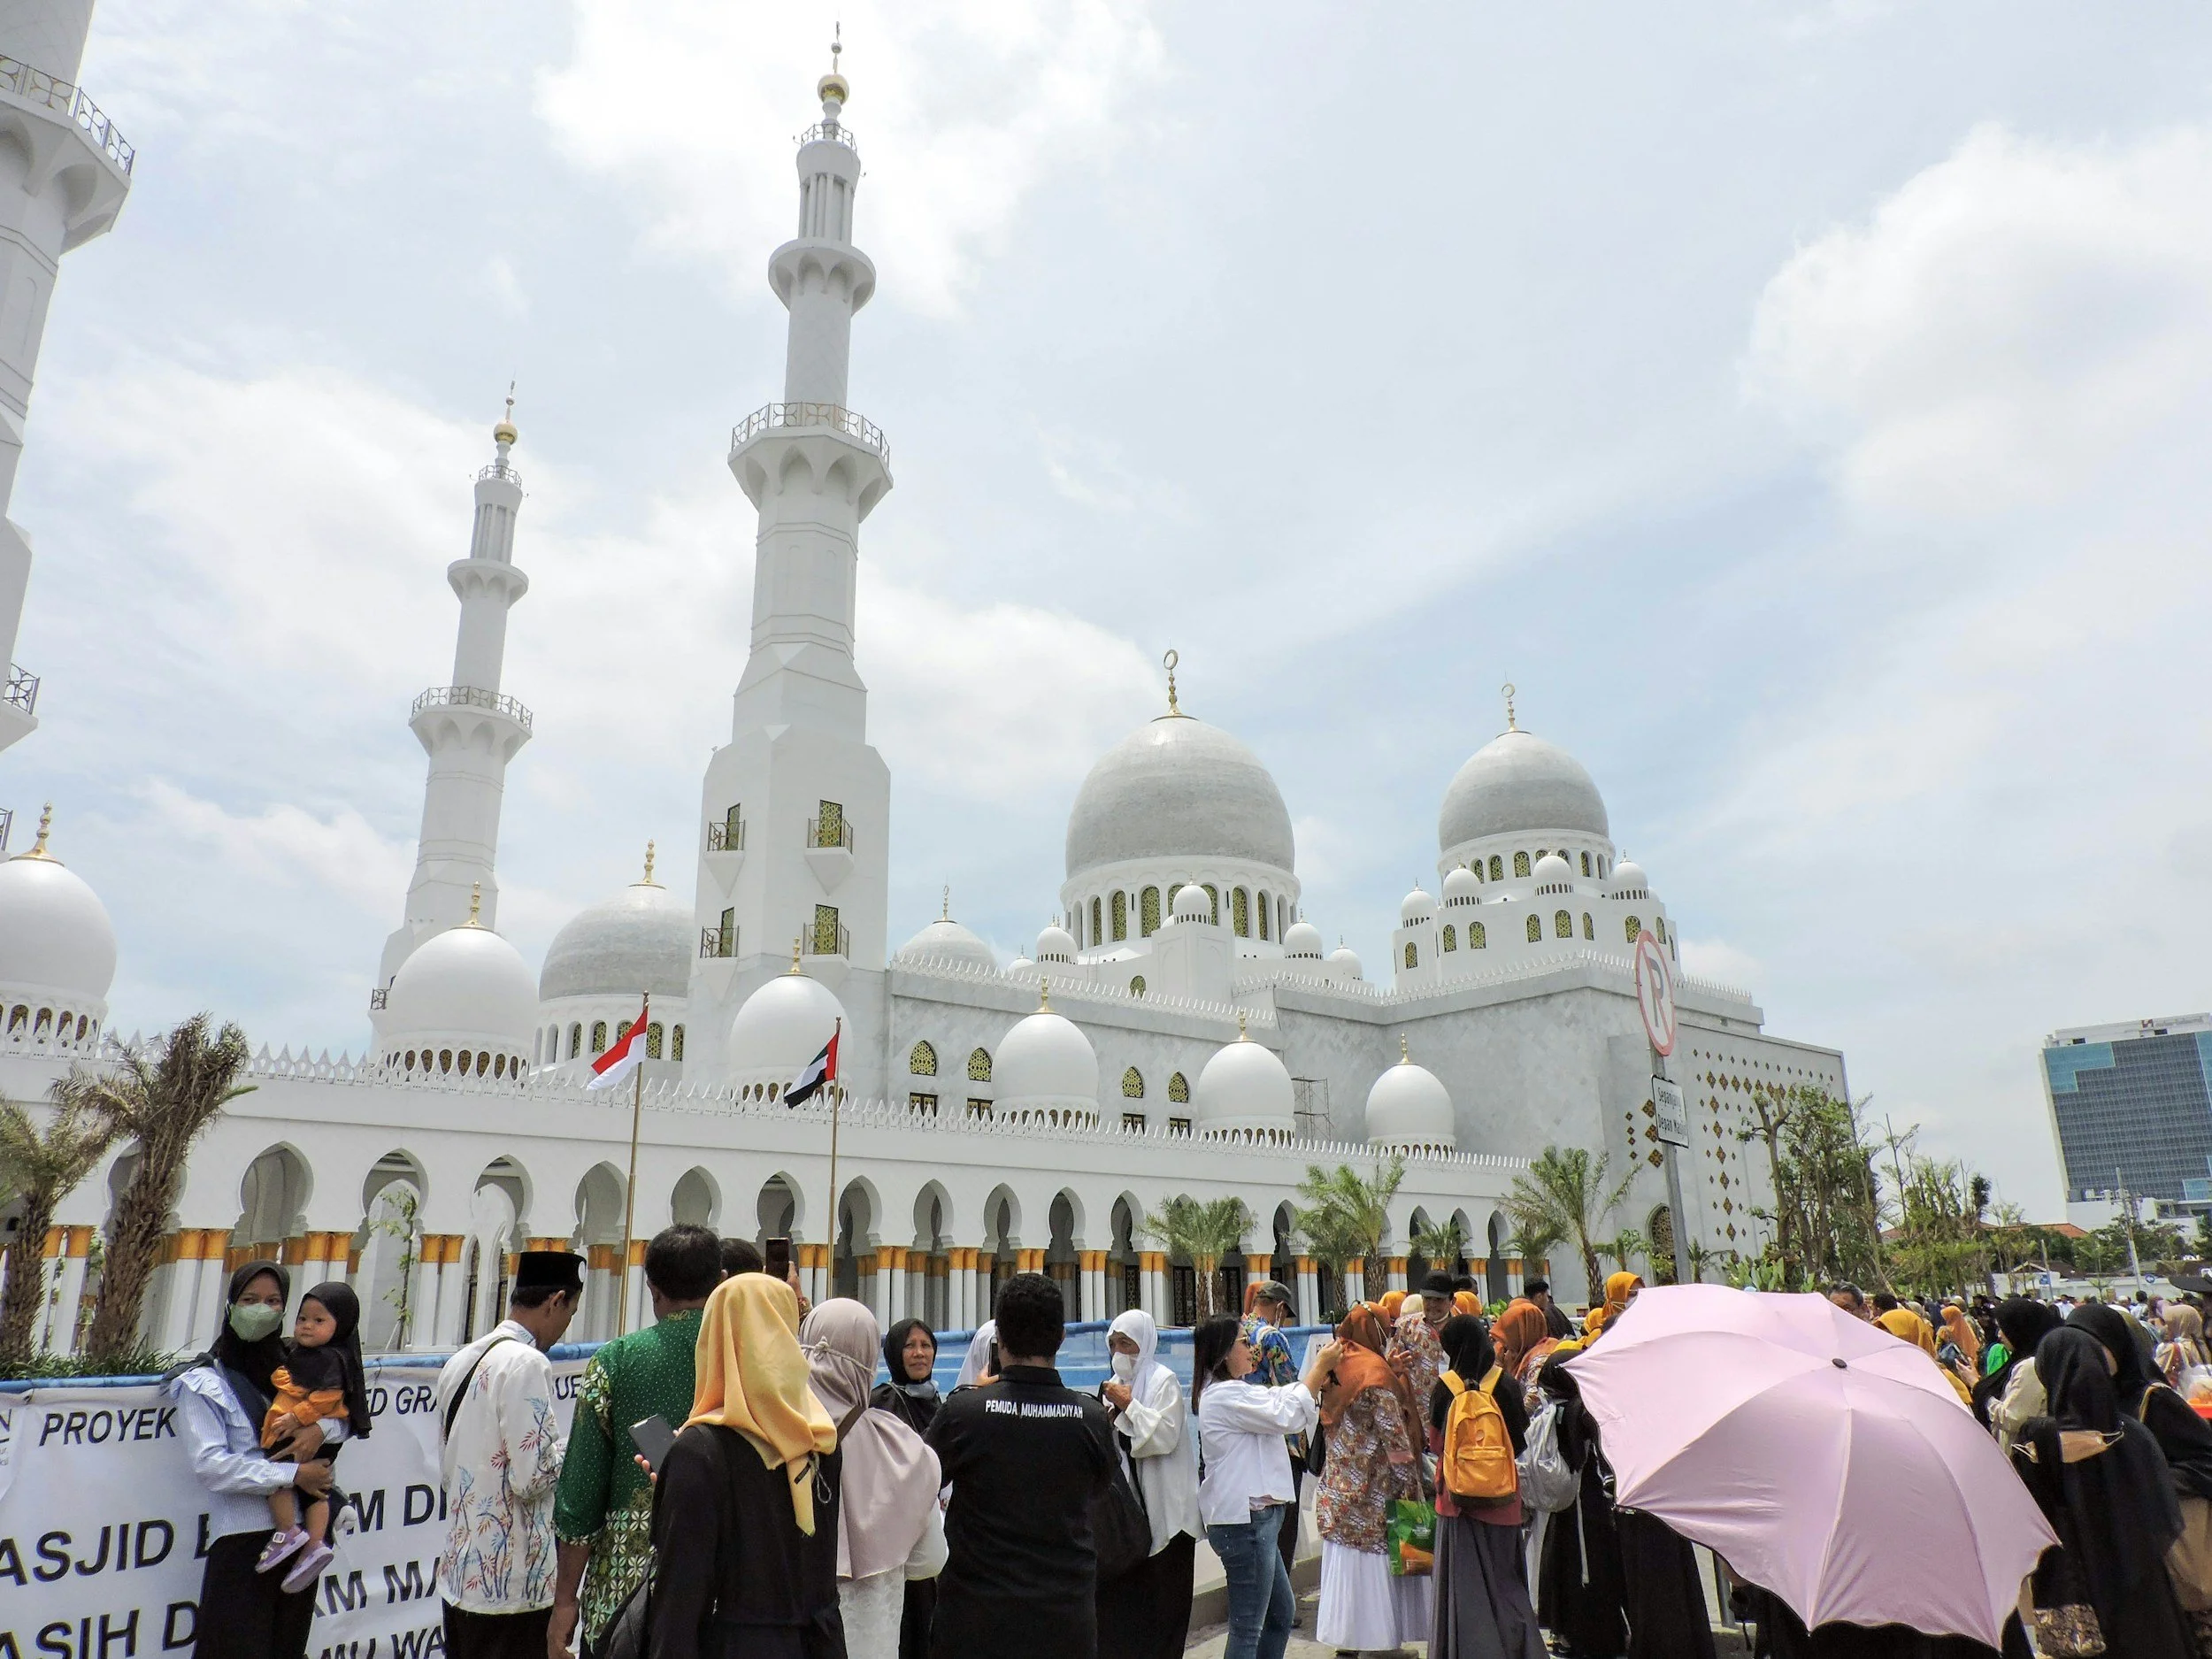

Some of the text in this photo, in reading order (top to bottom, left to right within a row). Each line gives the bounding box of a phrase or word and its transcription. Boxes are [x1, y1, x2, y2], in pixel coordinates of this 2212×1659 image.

[39, 1407, 177, 1447] PROYEK
[552, 1374, 583, 1401] UE
[985, 1400, 1083, 1419] PEMUDA MUHAMMADIYAH
